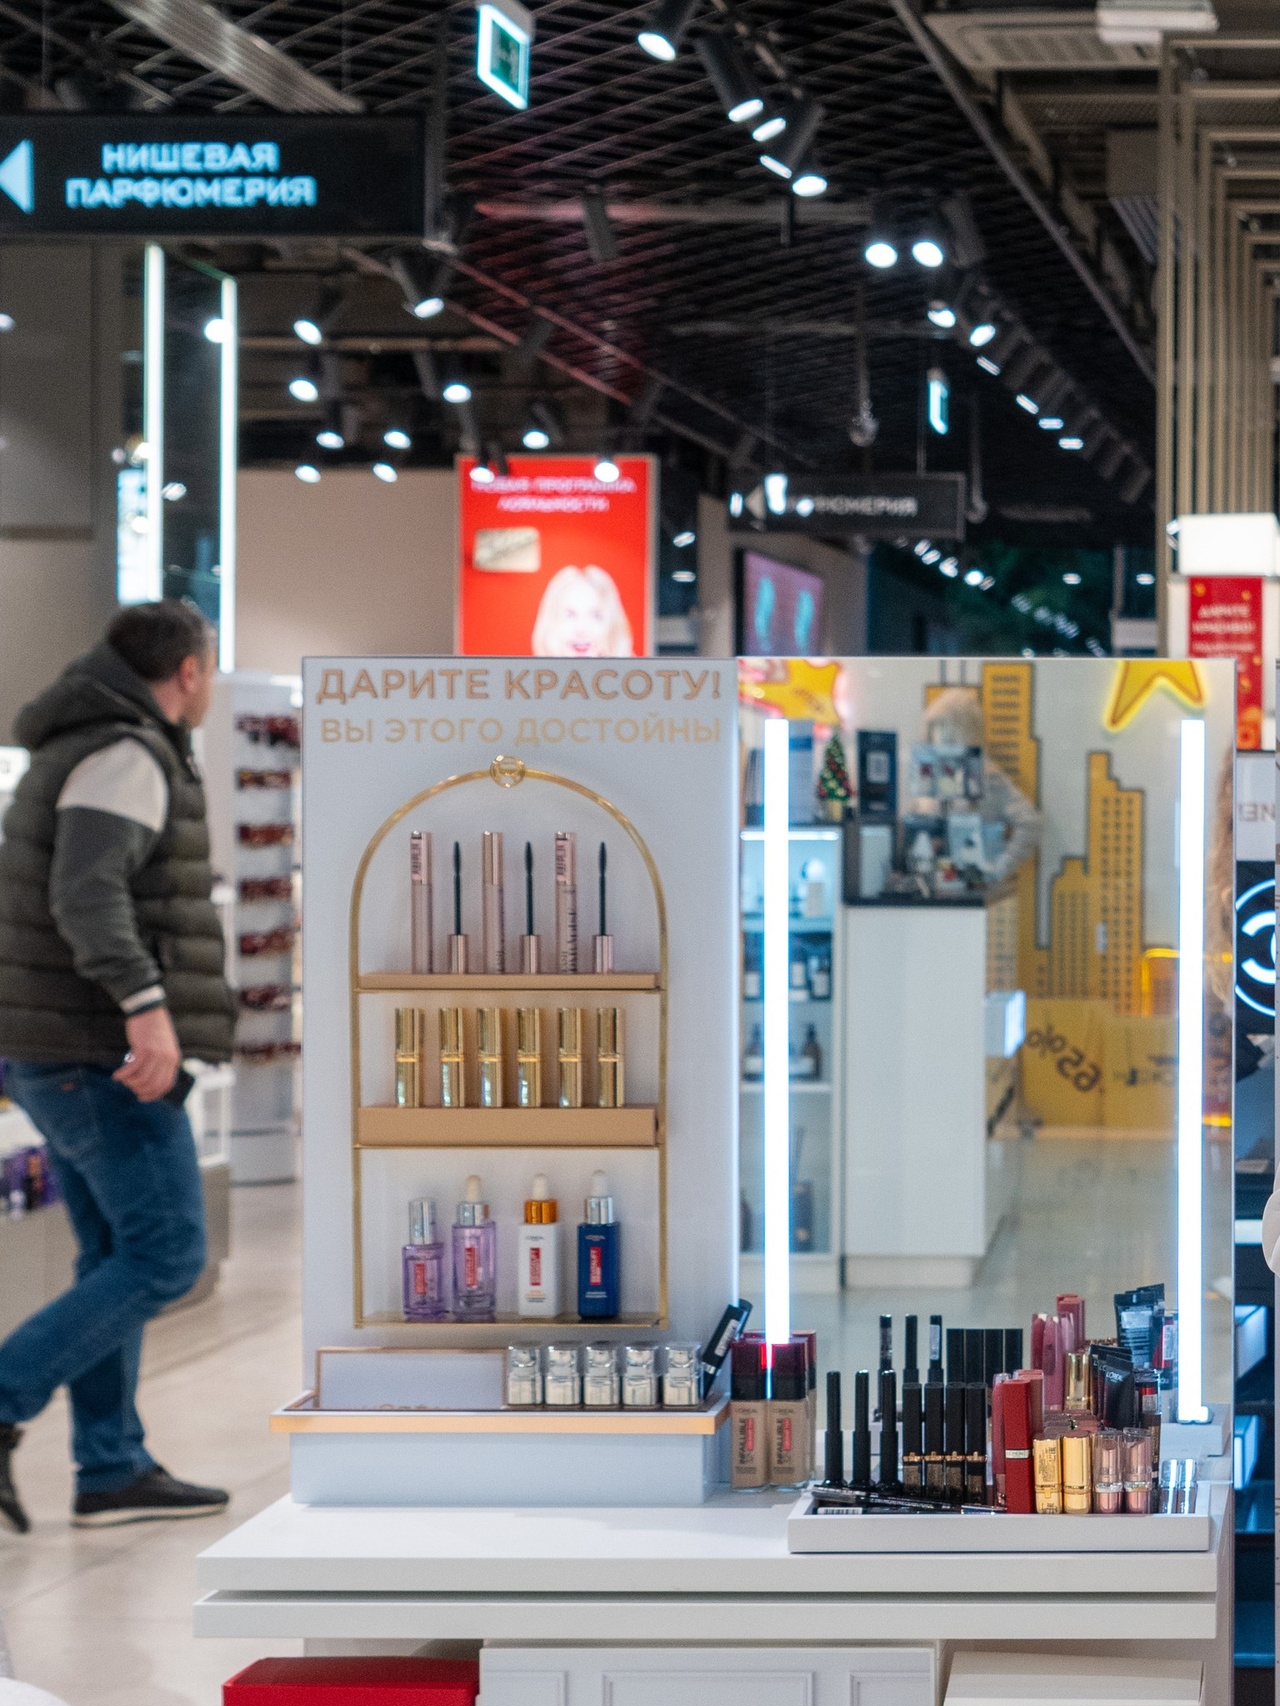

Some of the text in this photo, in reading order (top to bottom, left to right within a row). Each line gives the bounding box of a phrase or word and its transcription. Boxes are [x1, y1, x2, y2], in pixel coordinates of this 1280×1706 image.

[103, 142, 280, 171] НИШЕВАЯ
[66, 176, 317, 209] ПАРФЮМЕРИЯ
[316, 669, 722, 704] ДАРИТЕ КРАСОТУ!
[321, 712, 722, 747] ВЫ ЭТОГО ДОСТОЙНЫ
